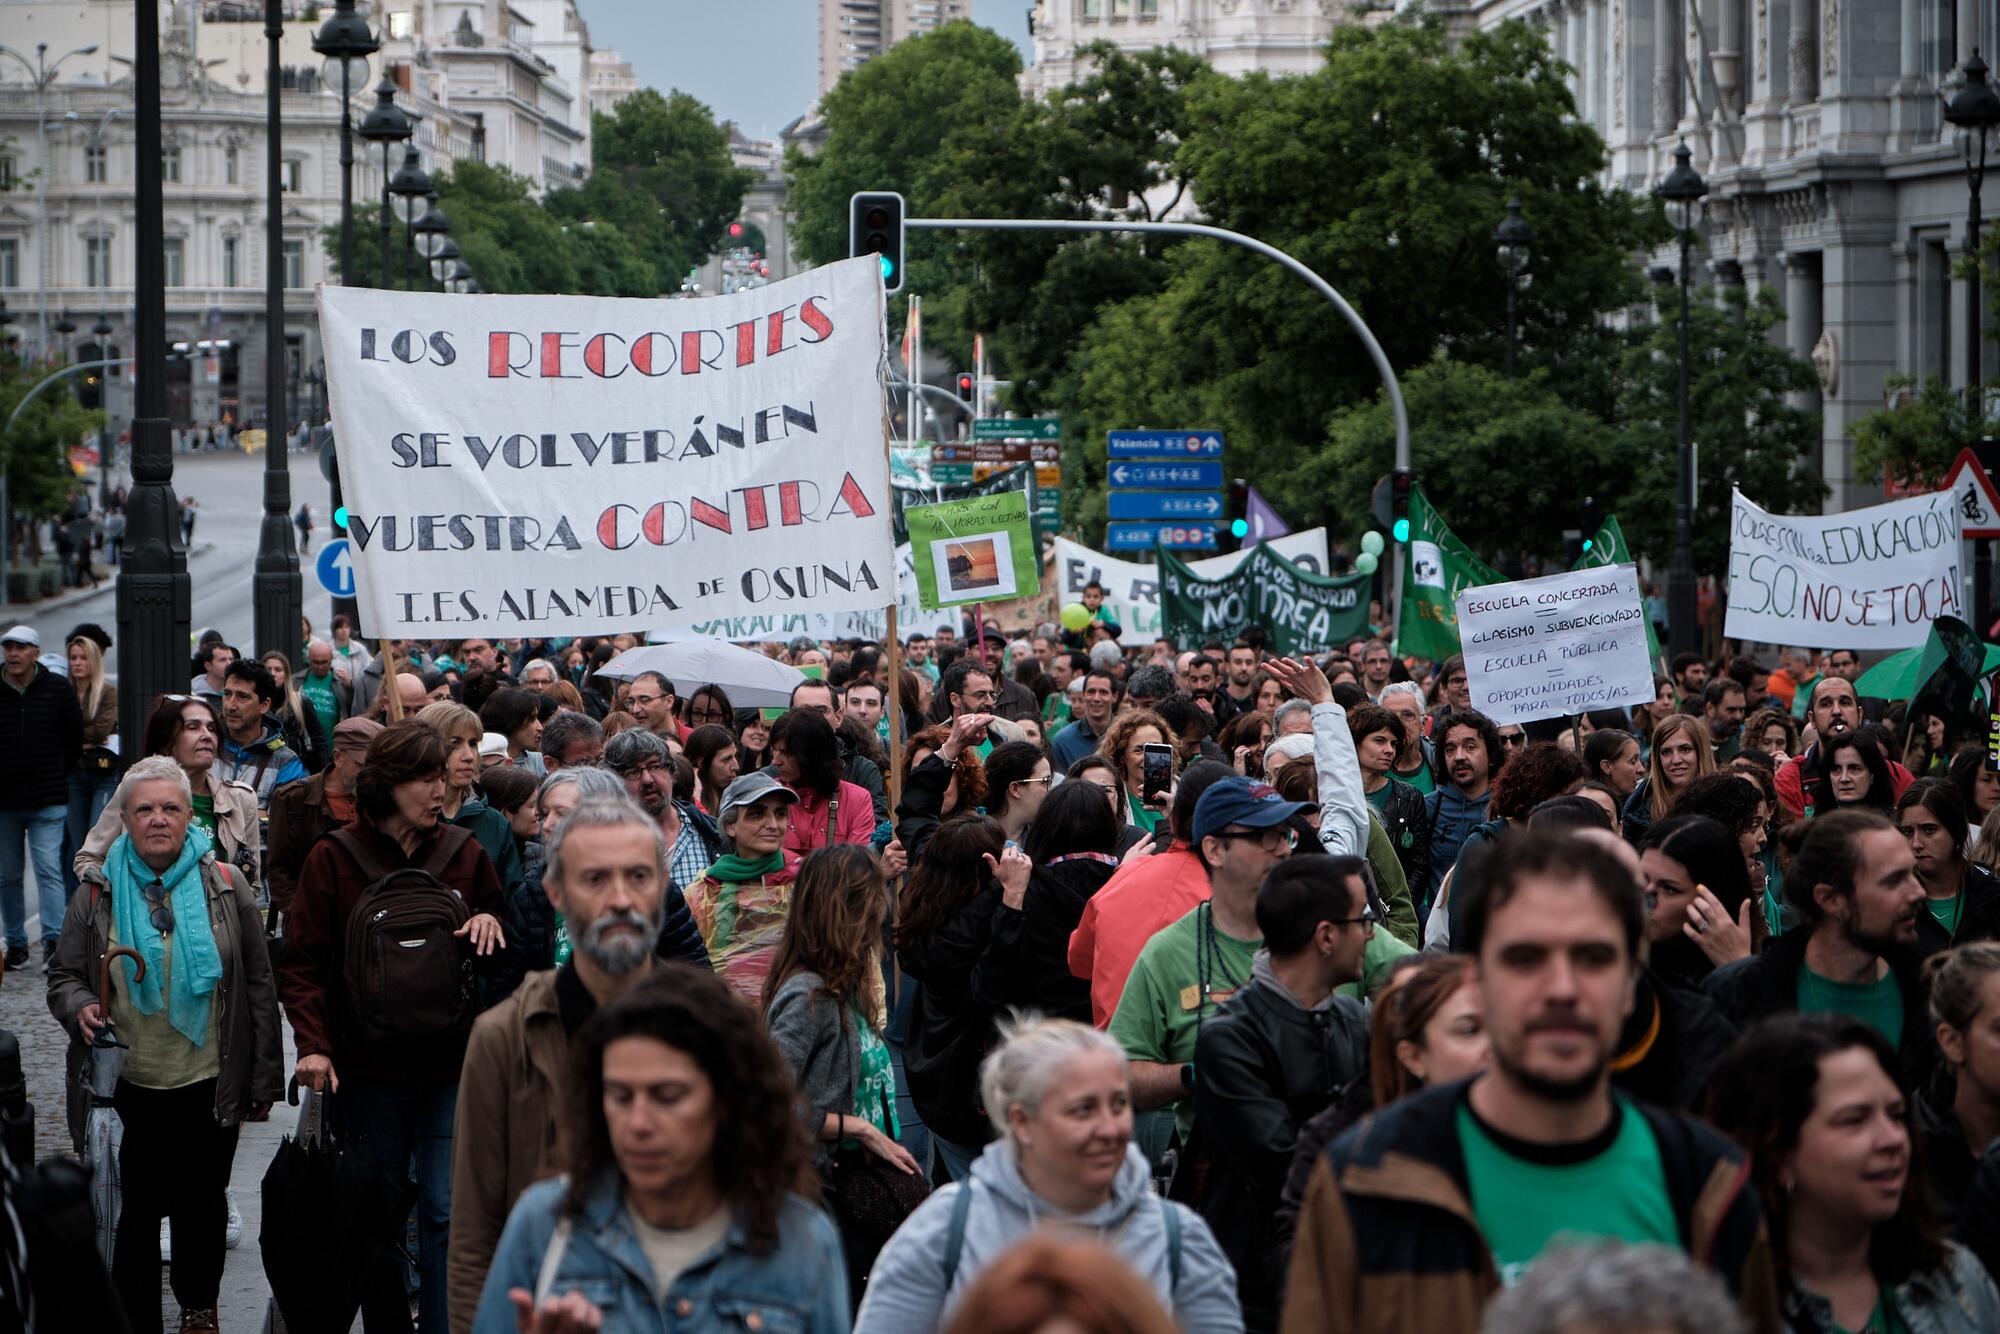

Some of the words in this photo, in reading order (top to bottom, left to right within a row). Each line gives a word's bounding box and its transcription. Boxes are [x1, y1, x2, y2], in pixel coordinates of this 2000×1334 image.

[360, 327, 457, 367] LOS
[487, 295, 835, 379] RECORTES
[390, 432, 452, 469] SE
[462, 414, 745, 472] VOLVERÁN
[755, 401, 818, 444] EN
[1111, 438, 1160, 449] Valencia
[348, 513, 582, 553] VUESTRA
[596, 470, 876, 551] CONTRA
[953, 516, 985, 529] HORAS
[991, 511, 1027, 525] LECTIVAS
[981, 498, 1001, 511] CON
[1822, 498, 1957, 565] EDUCACIÓN
[397, 589, 489, 624] I.E.S.
[497, 583, 681, 622] ALAMEDA
[697, 576, 725, 599] DE
[740, 559, 881, 604] OSUNA
[1066, 557, 1112, 597] EL
[1468, 595, 1530, 615] ESCUELA
[1537, 582, 1620, 605] CONCERTADA
[1802, 582, 1842, 623] NO
[1845, 589, 1878, 627] SE
[1882, 564, 1963, 627] TOCA!
[1484, 649, 1547, 673] ESCUELA
[1558, 640, 1619, 660] PÚBLICA
[1487, 675, 1604, 704] OPORTUNIDADES
[1511, 700, 1550, 715] PARA
[1565, 685, 1629, 706] TODOS/AS
